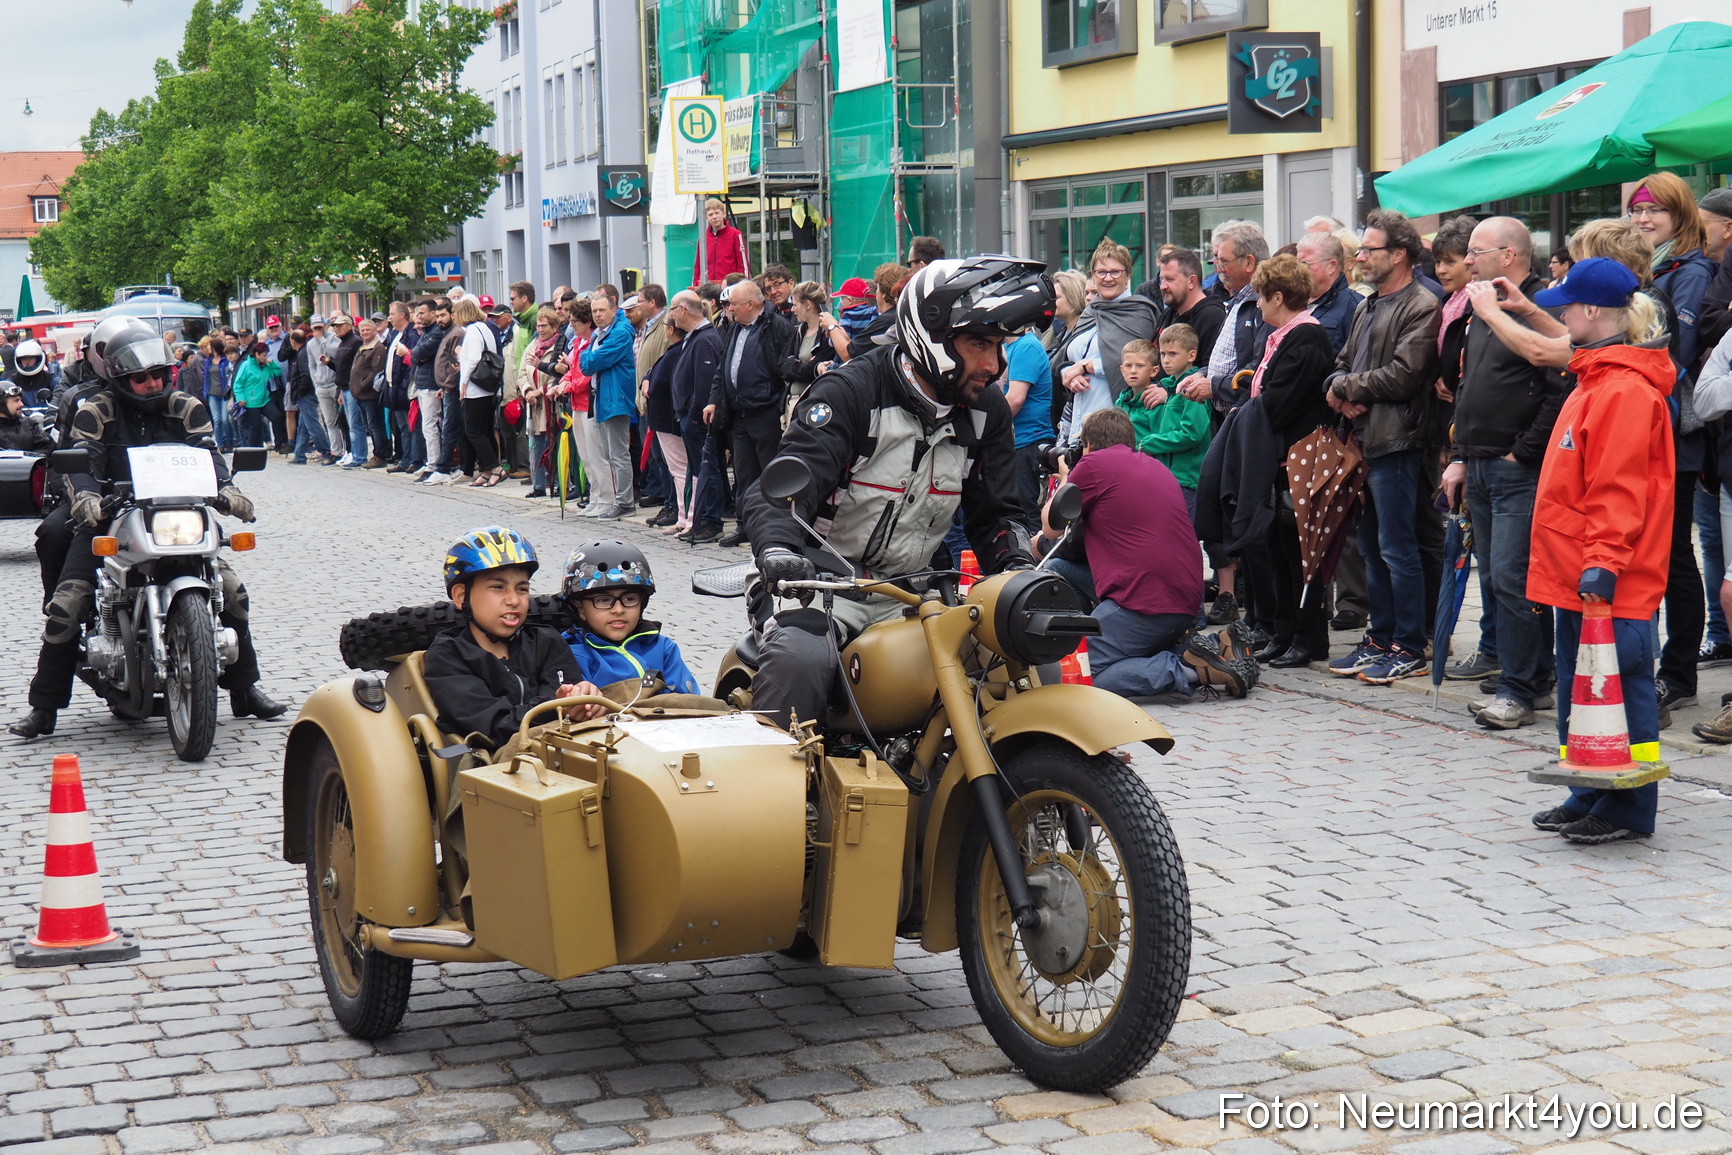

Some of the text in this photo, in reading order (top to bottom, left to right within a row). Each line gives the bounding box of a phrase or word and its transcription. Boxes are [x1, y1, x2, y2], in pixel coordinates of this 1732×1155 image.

[1426, 0, 1497, 32] Unterer Markt 15
[1266, 59, 1298, 100] G2
[689, 112, 706, 134] H
[616, 178, 634, 200] G2
[171, 456, 198, 467] 583
